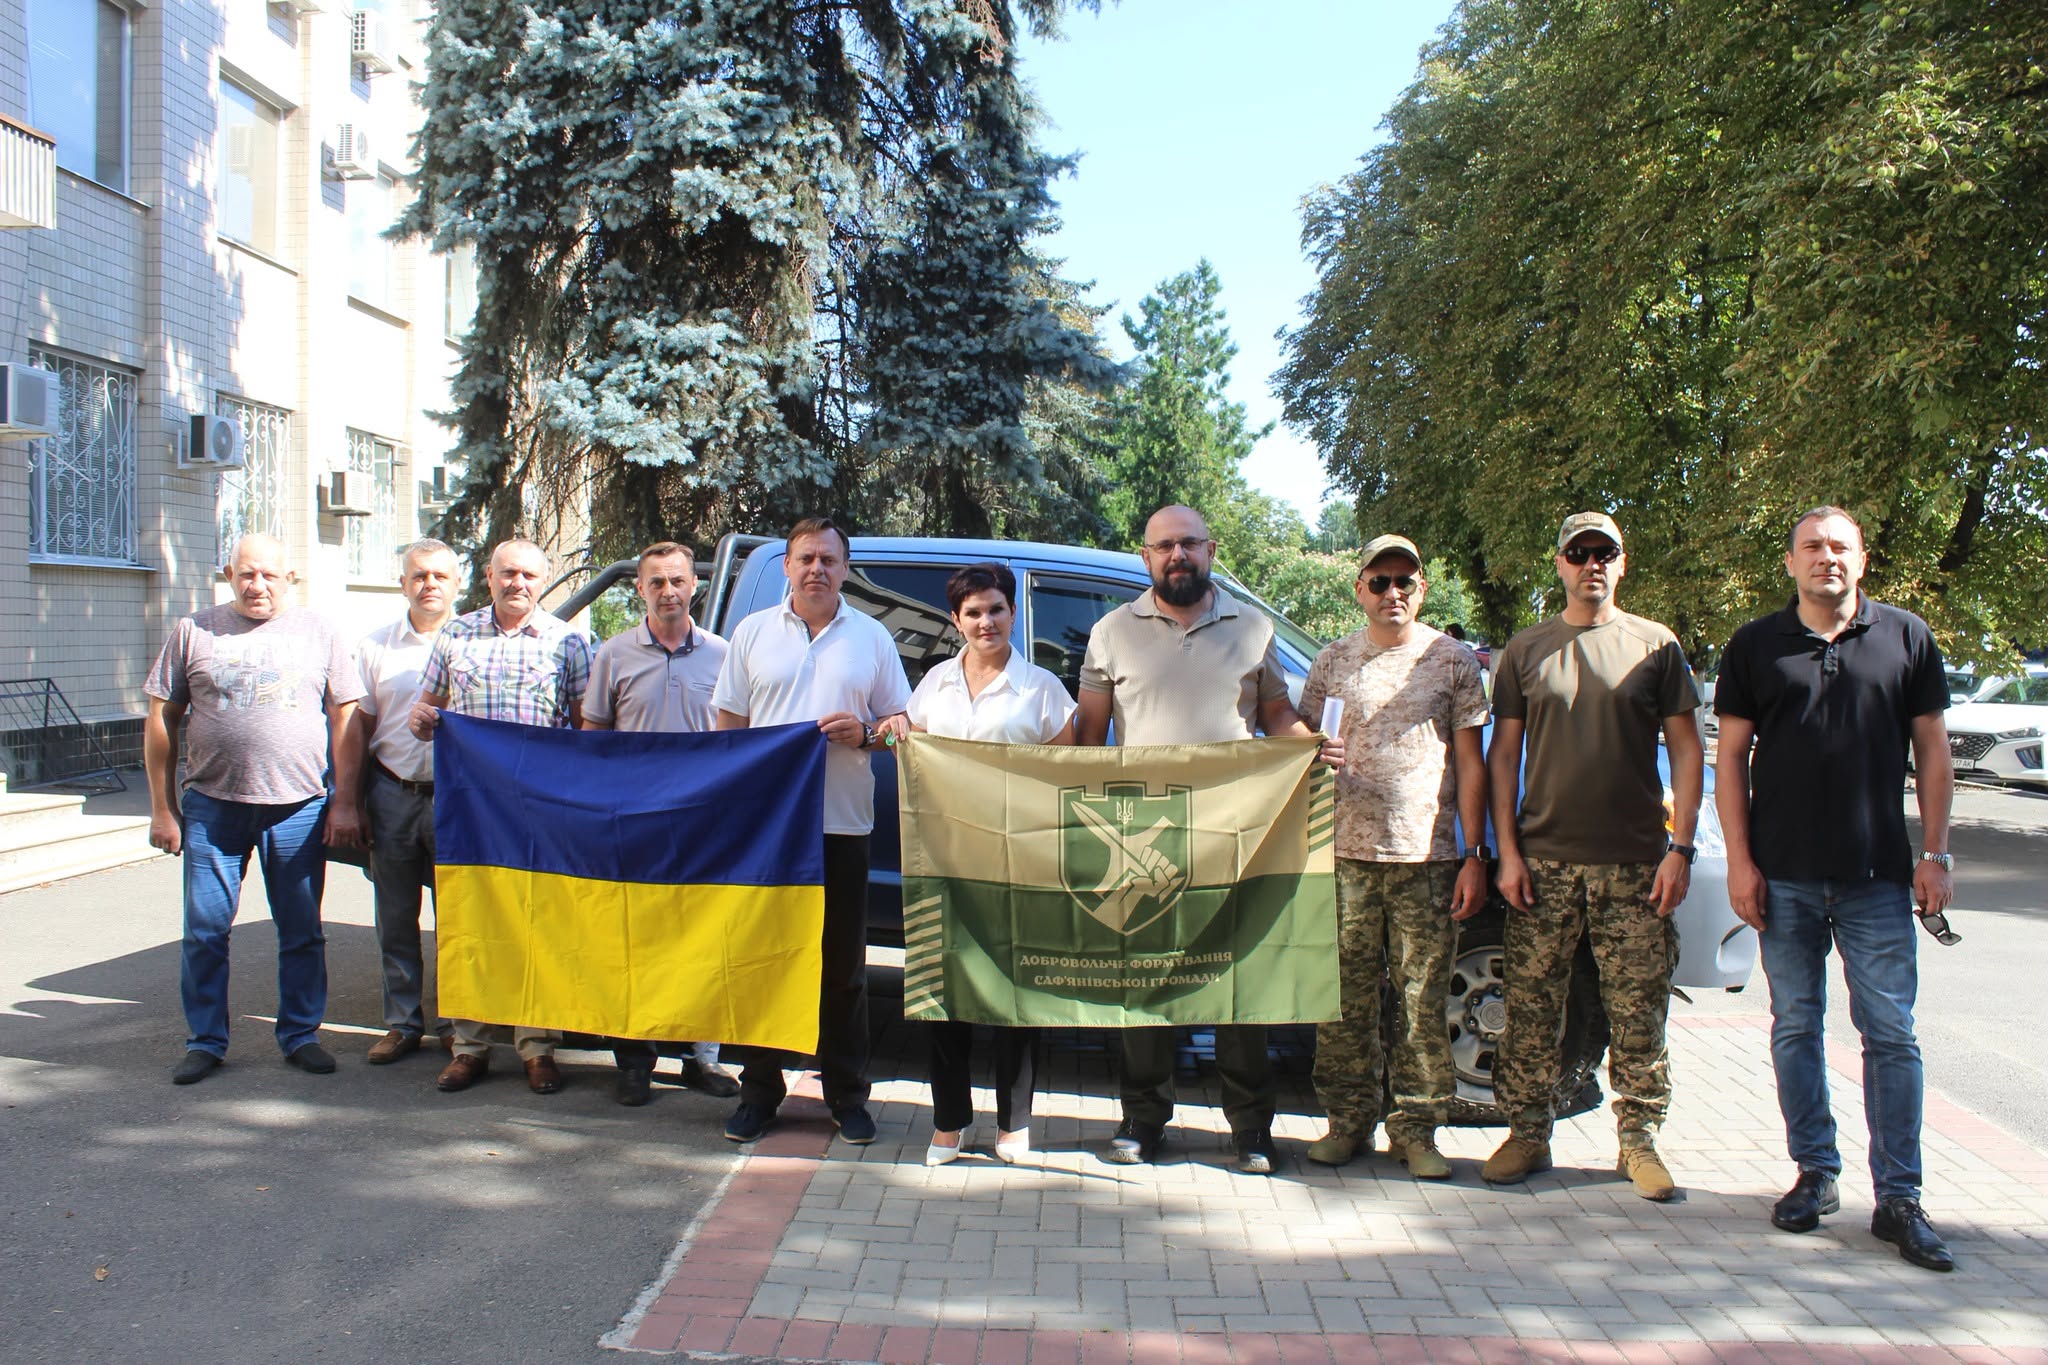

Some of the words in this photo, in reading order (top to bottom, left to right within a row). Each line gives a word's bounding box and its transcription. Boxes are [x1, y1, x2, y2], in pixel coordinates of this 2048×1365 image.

[1019, 954, 1127, 969] ДОБРОВОЛЬЧЕ
[1130, 951, 1233, 969] ФОРМУВАННЯ
[1150, 972, 1221, 988] ГРОМАДИ
